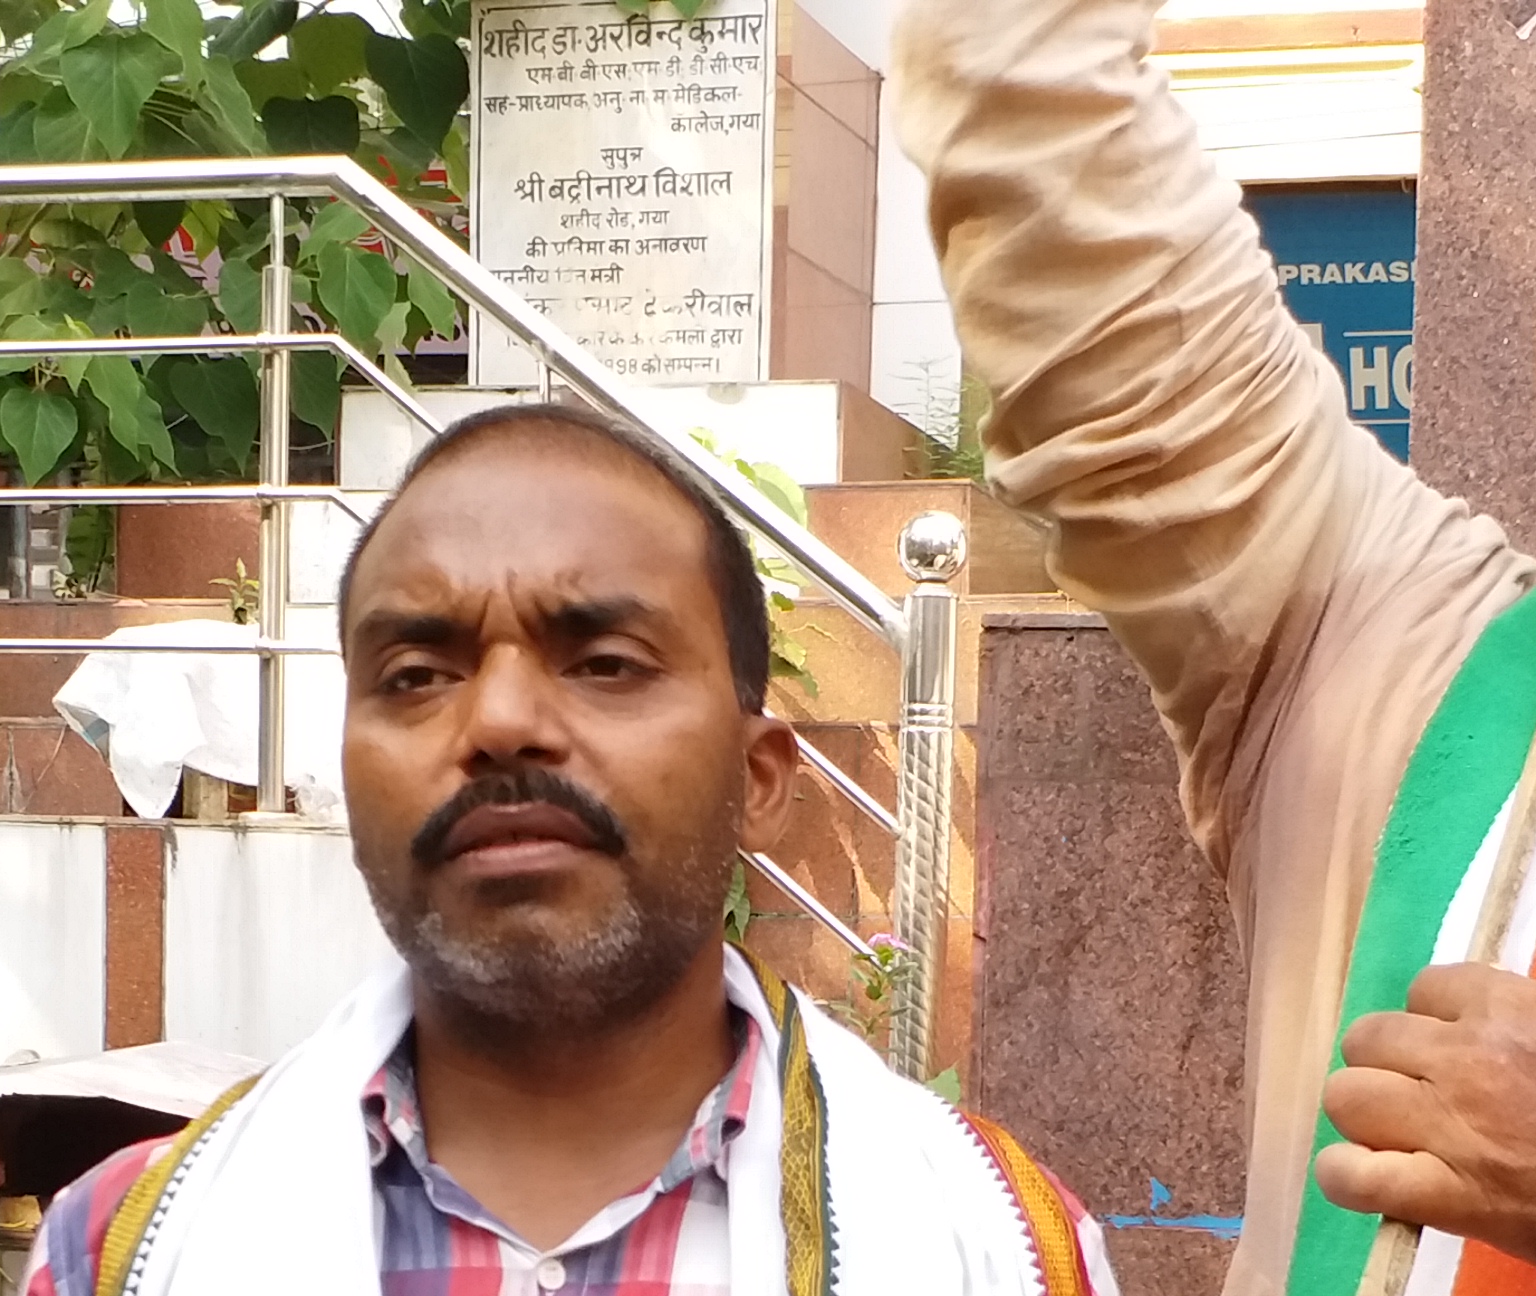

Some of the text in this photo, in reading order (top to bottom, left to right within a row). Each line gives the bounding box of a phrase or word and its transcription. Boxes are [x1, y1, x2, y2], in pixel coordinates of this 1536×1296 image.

[484, 13, 763, 58] शहीद अरविन्द कुमार
[514, 171, 545, 203] श्री
[653, 166, 733, 198] विशाल
[526, 236, 548, 258] की
[608, 239, 631, 255] का
